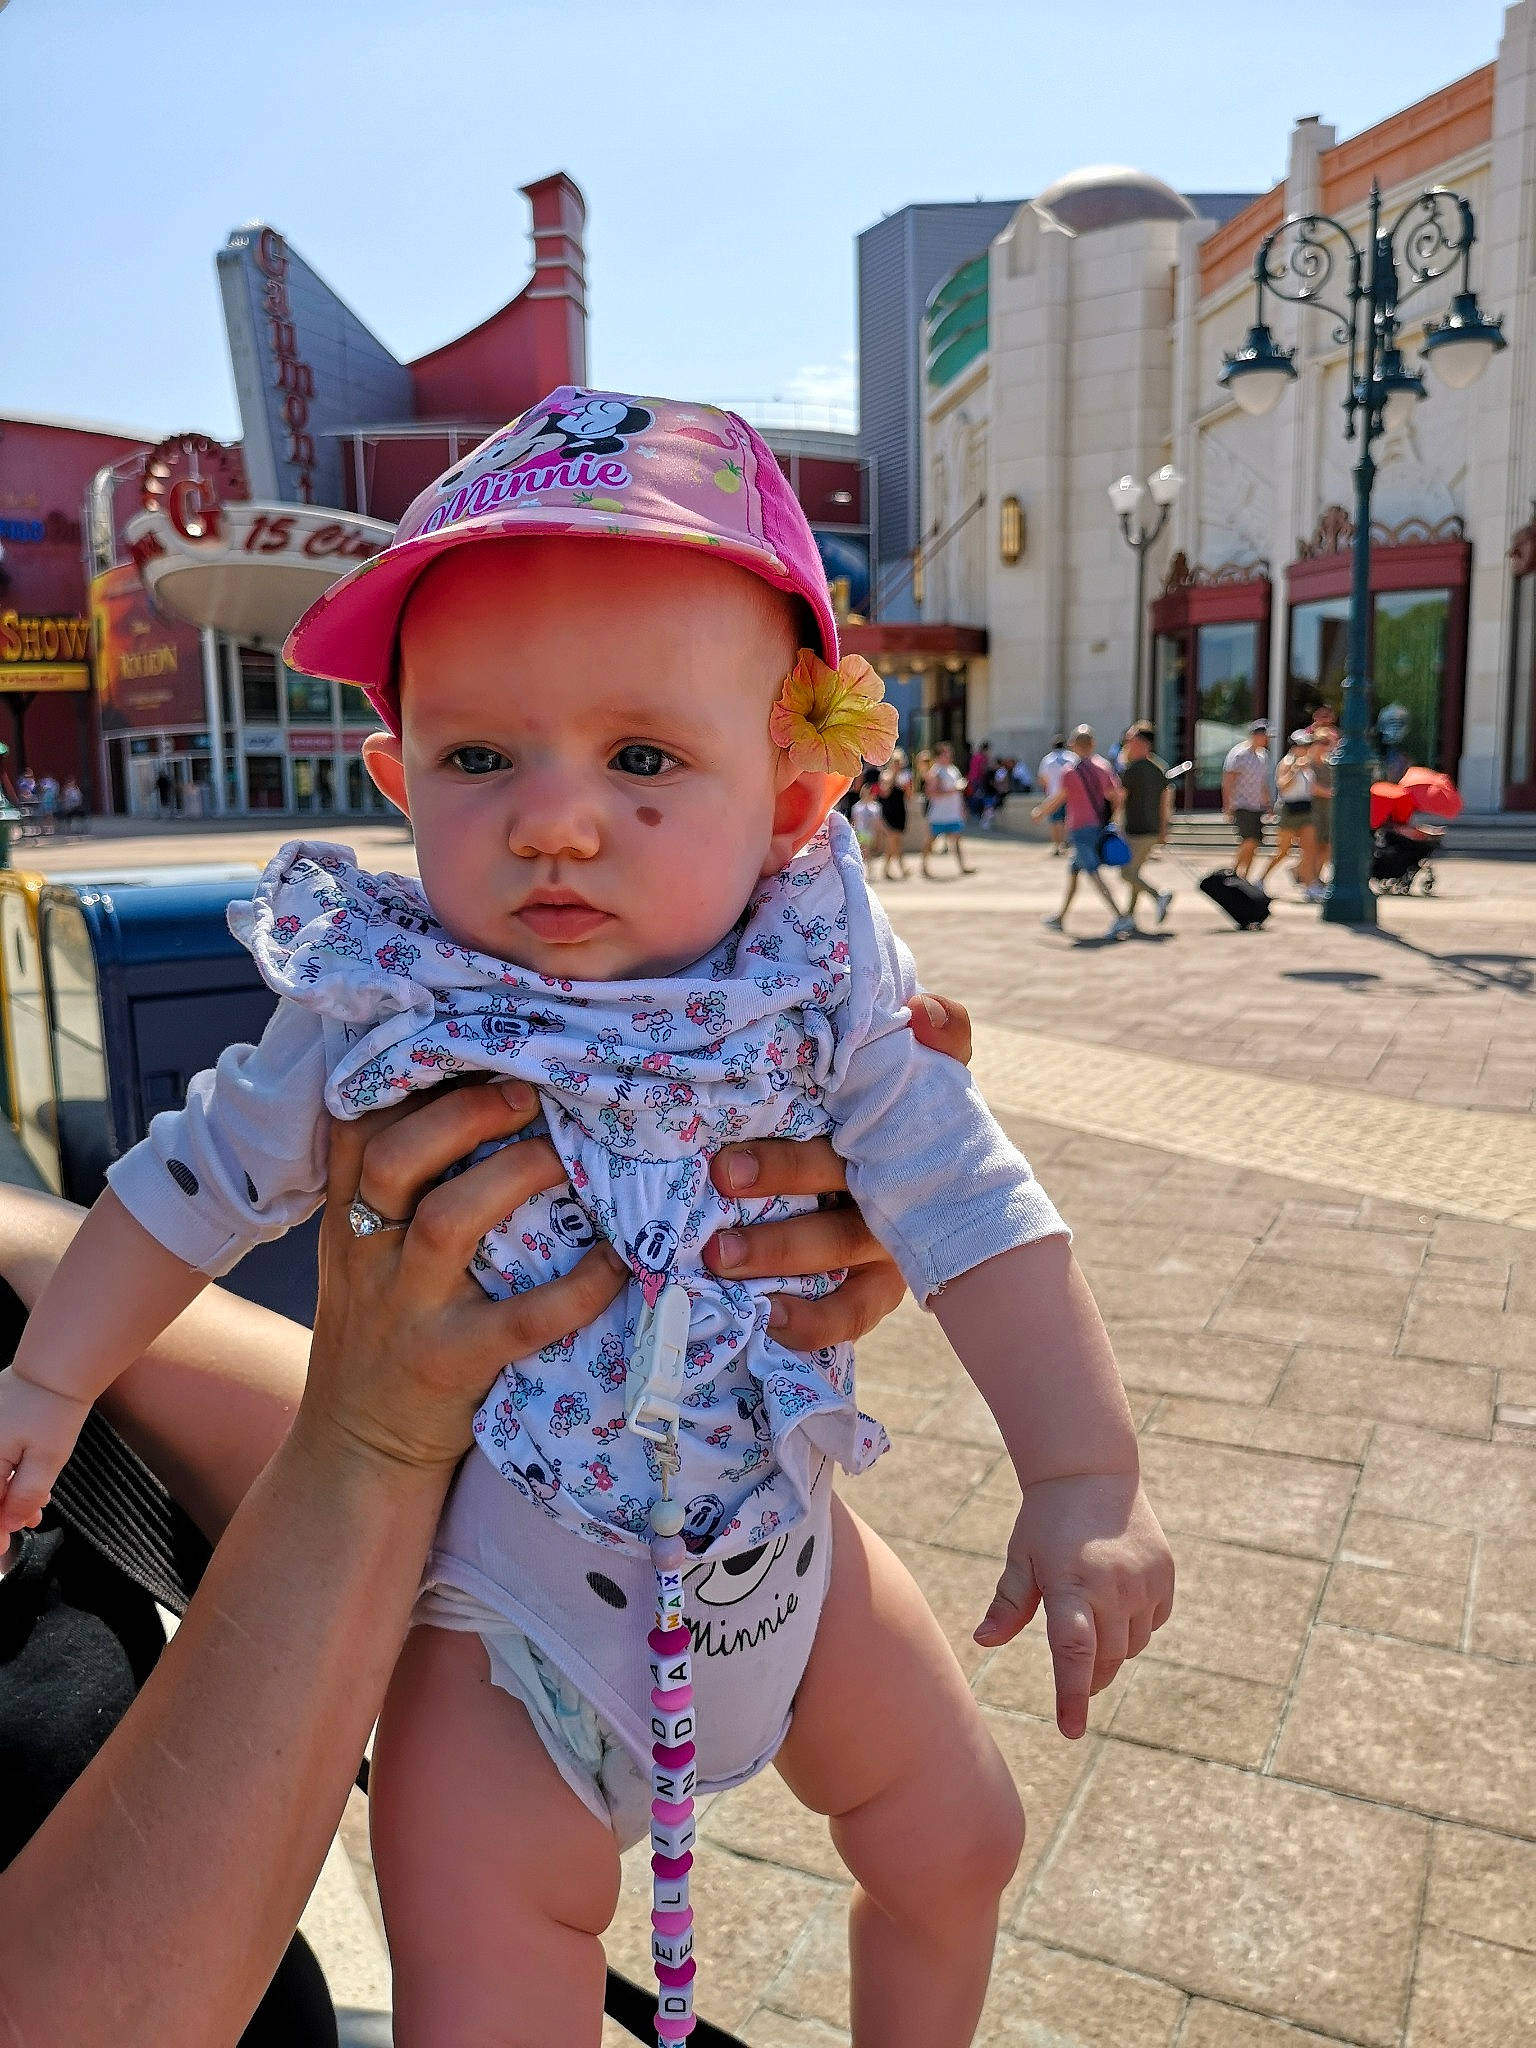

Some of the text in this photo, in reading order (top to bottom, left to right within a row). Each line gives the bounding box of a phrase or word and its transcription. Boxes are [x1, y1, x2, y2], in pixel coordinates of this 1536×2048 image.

[420, 453, 628, 535] Minnie
[244, 515, 297, 553] 15
[682, 1591, 799, 1657] Minnie
